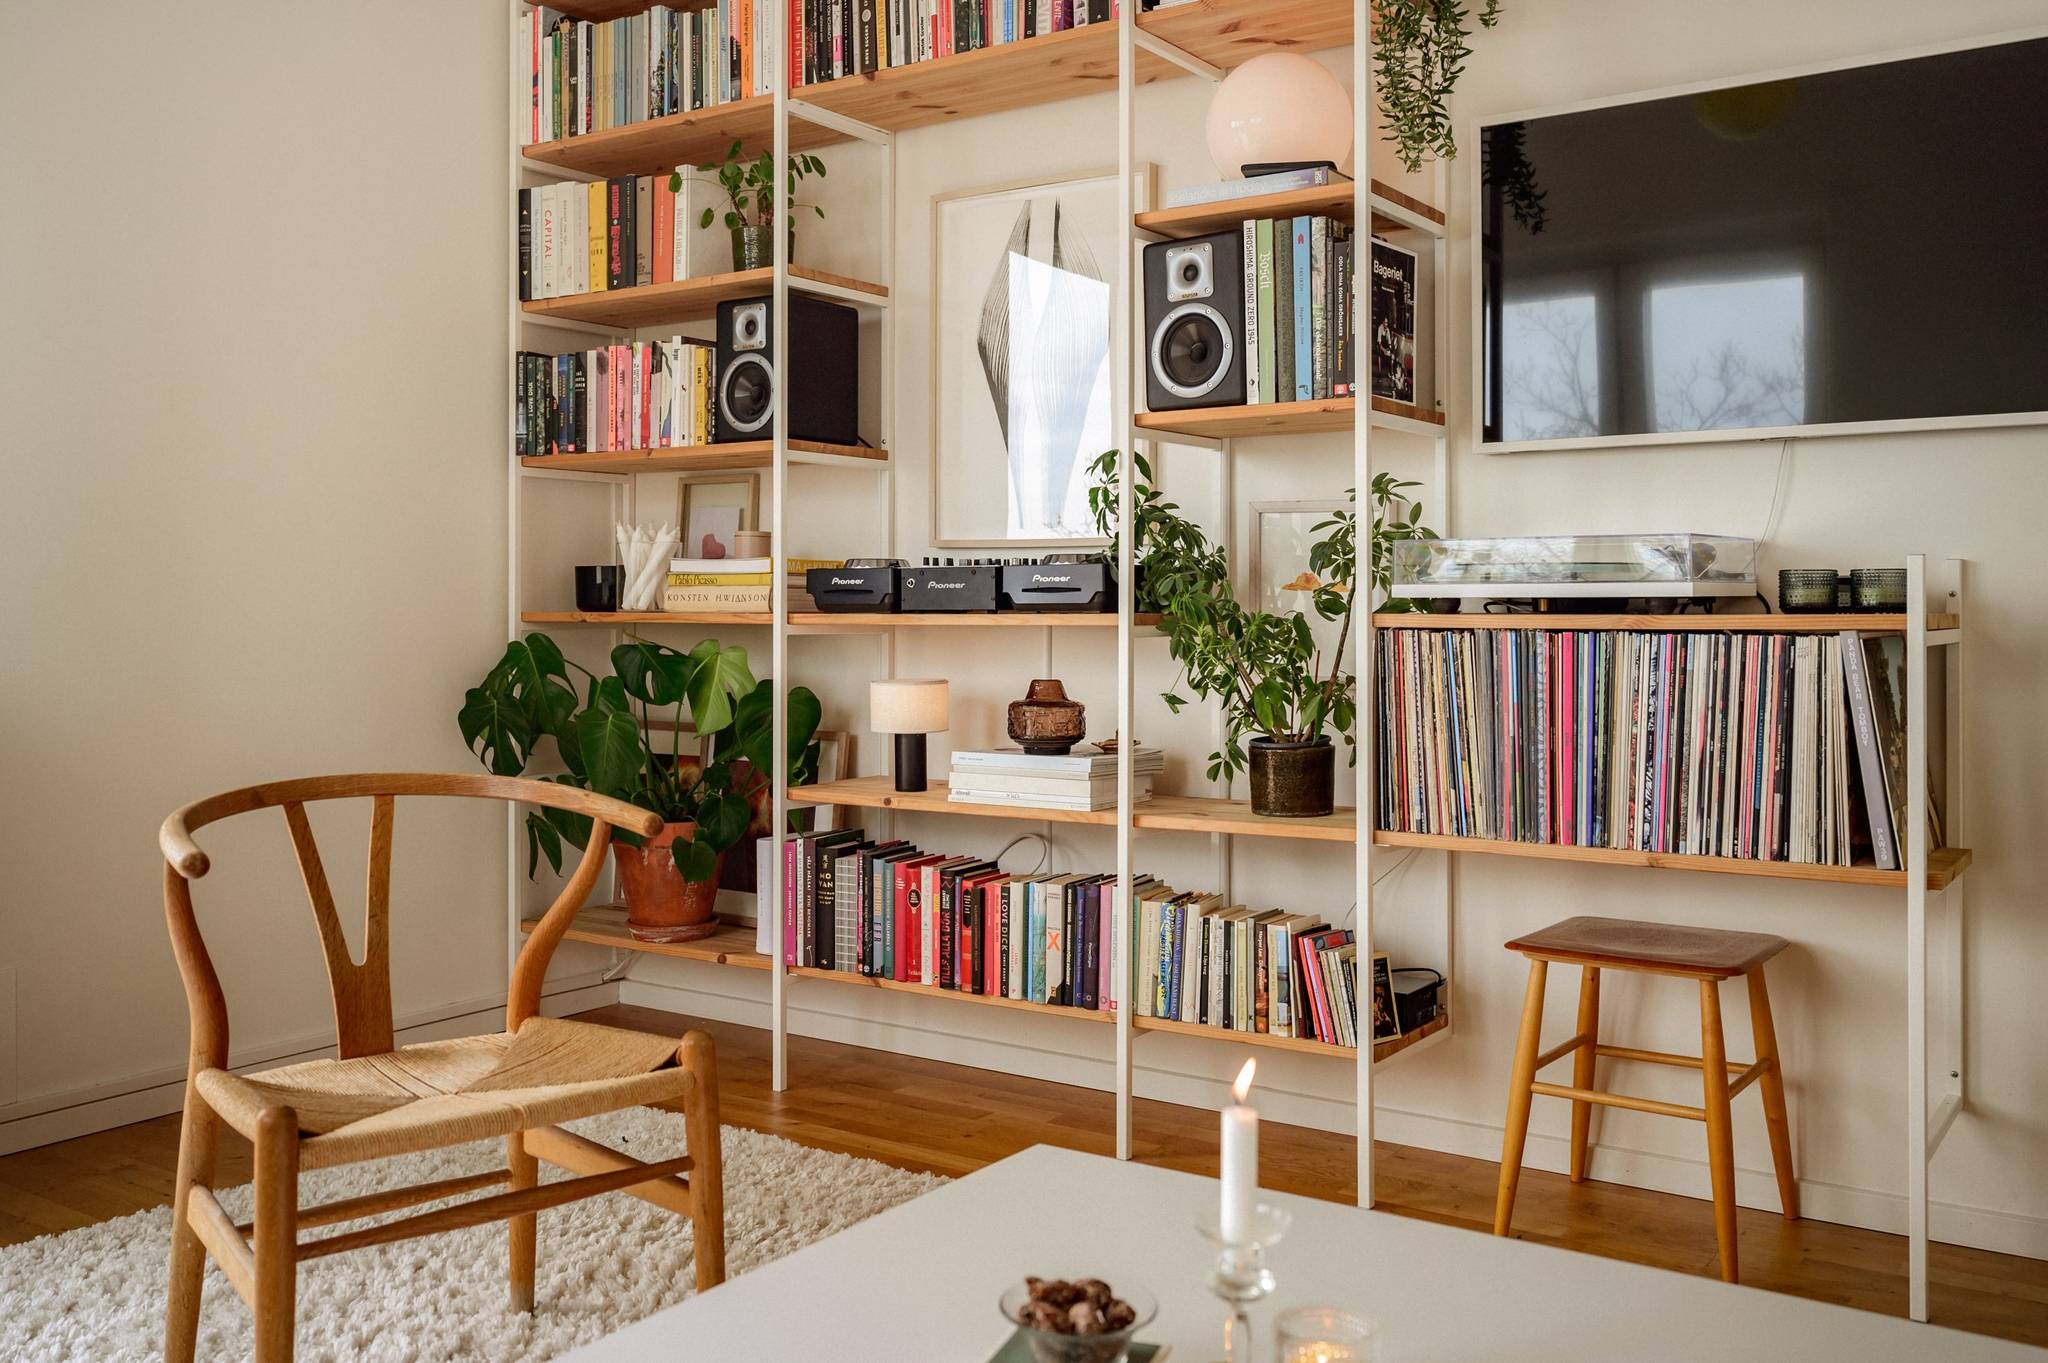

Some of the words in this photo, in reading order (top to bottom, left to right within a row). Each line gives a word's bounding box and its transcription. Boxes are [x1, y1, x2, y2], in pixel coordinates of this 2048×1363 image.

[544, 209, 552, 259] CAPITAL
[1259, 251, 1272, 289] Bosch
[1373, 260, 1403, 282] Bageriet
[1248, 328, 1256, 345] 1945
[674, 574, 694, 584] Pablo
[694, 574, 718, 585] Picasso
[831, 577, 864, 585] Pioneer
[927, 581, 966, 589] Pioneer
[1032, 574, 1071, 583] Pioneer
[667, 593, 709, 602] KONSTEN
[1847, 638, 1858, 670] PANDA
[1852, 674, 1862, 701] BEAR
[1857, 706, 1870, 748] TOMBOY
[818, 881, 834, 889] YAN
[941, 911, 951, 932] DÖR
[941, 935, 950, 958] ALLA
